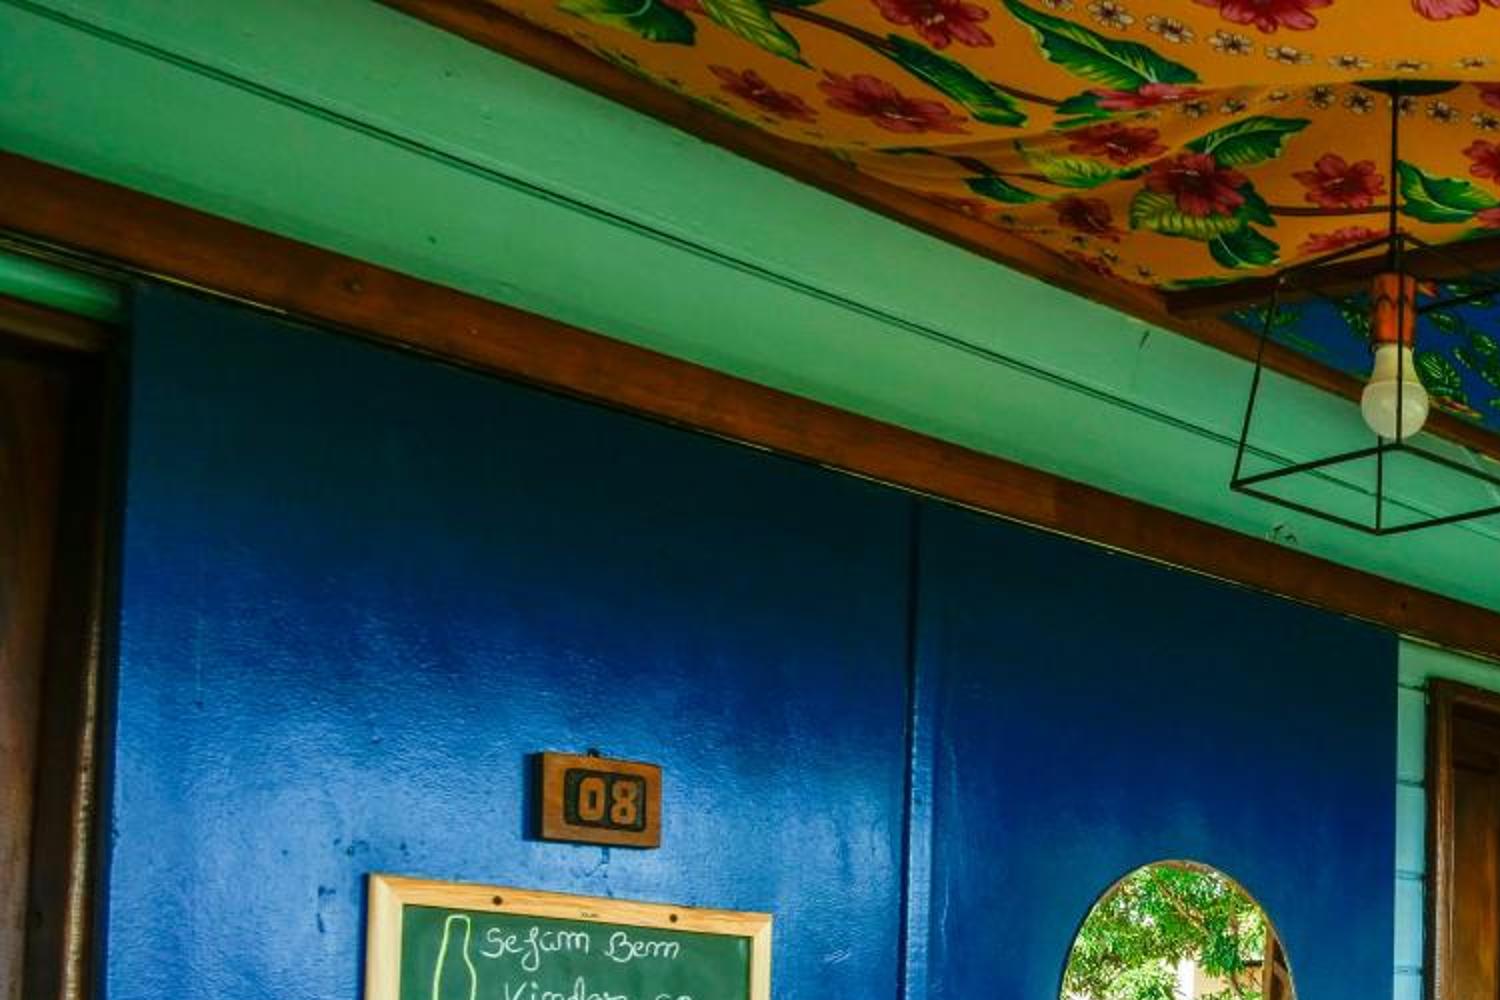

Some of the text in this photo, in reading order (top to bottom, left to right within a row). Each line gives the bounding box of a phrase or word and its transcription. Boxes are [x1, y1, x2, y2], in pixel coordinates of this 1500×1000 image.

[578, 776, 637, 825] 08
[481, 926, 680, 971] Sejam Bem
